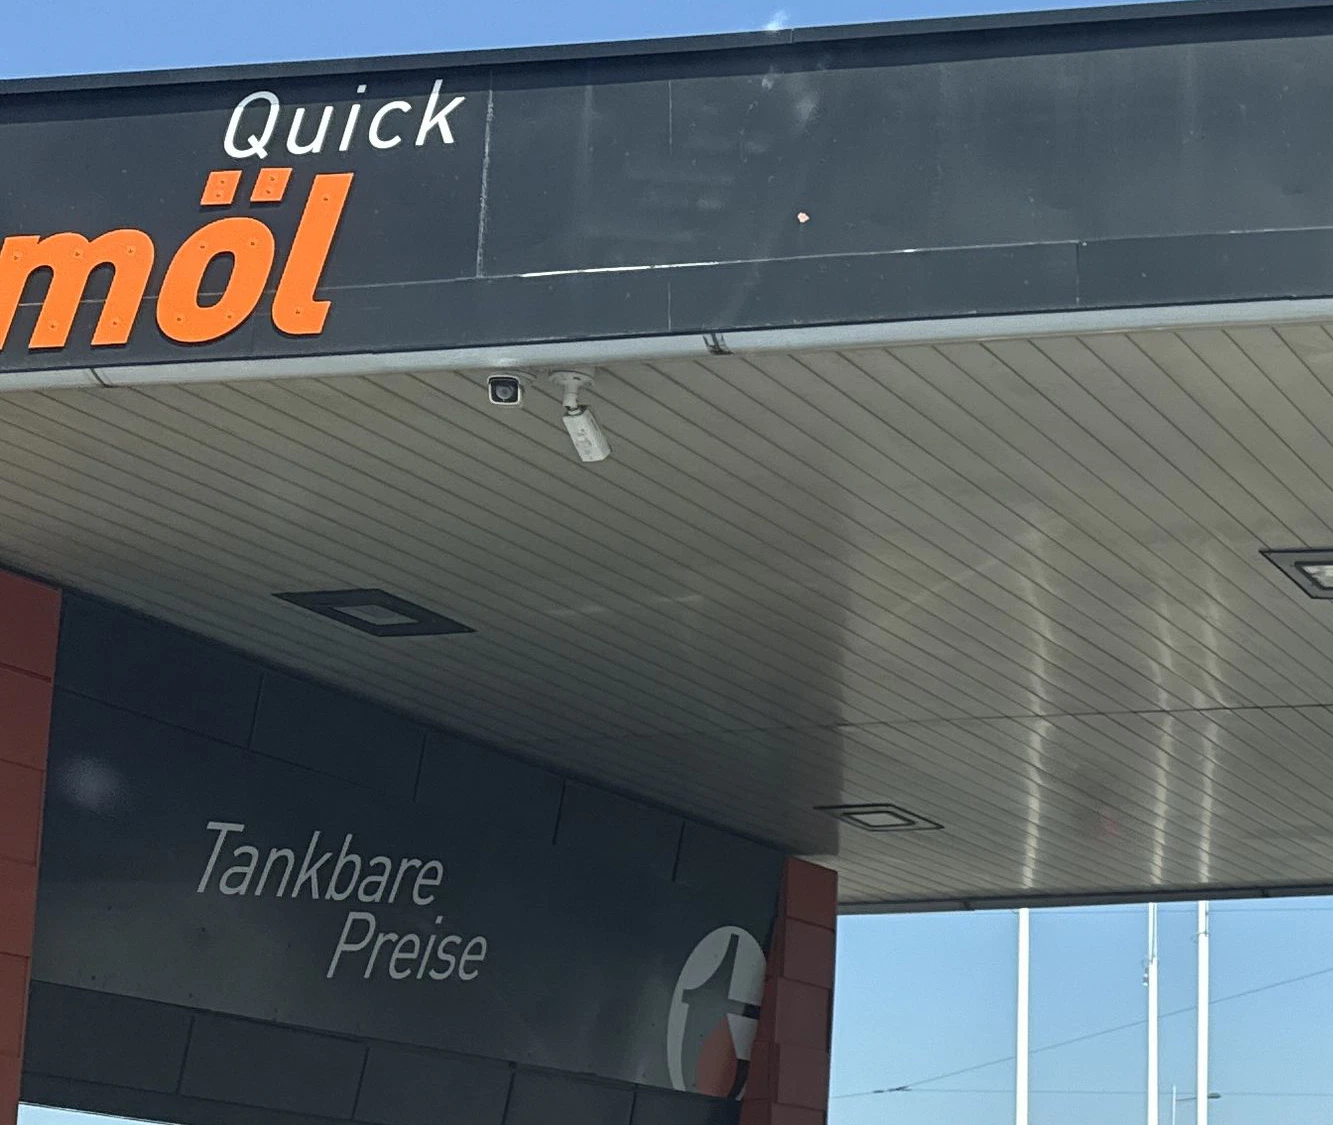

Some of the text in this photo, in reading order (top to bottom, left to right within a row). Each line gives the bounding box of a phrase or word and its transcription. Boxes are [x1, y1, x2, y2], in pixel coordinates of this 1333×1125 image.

[223, 78, 468, 159] Quick
[197, 821, 444, 907] Tankbare
[326, 911, 488, 982] Preise
